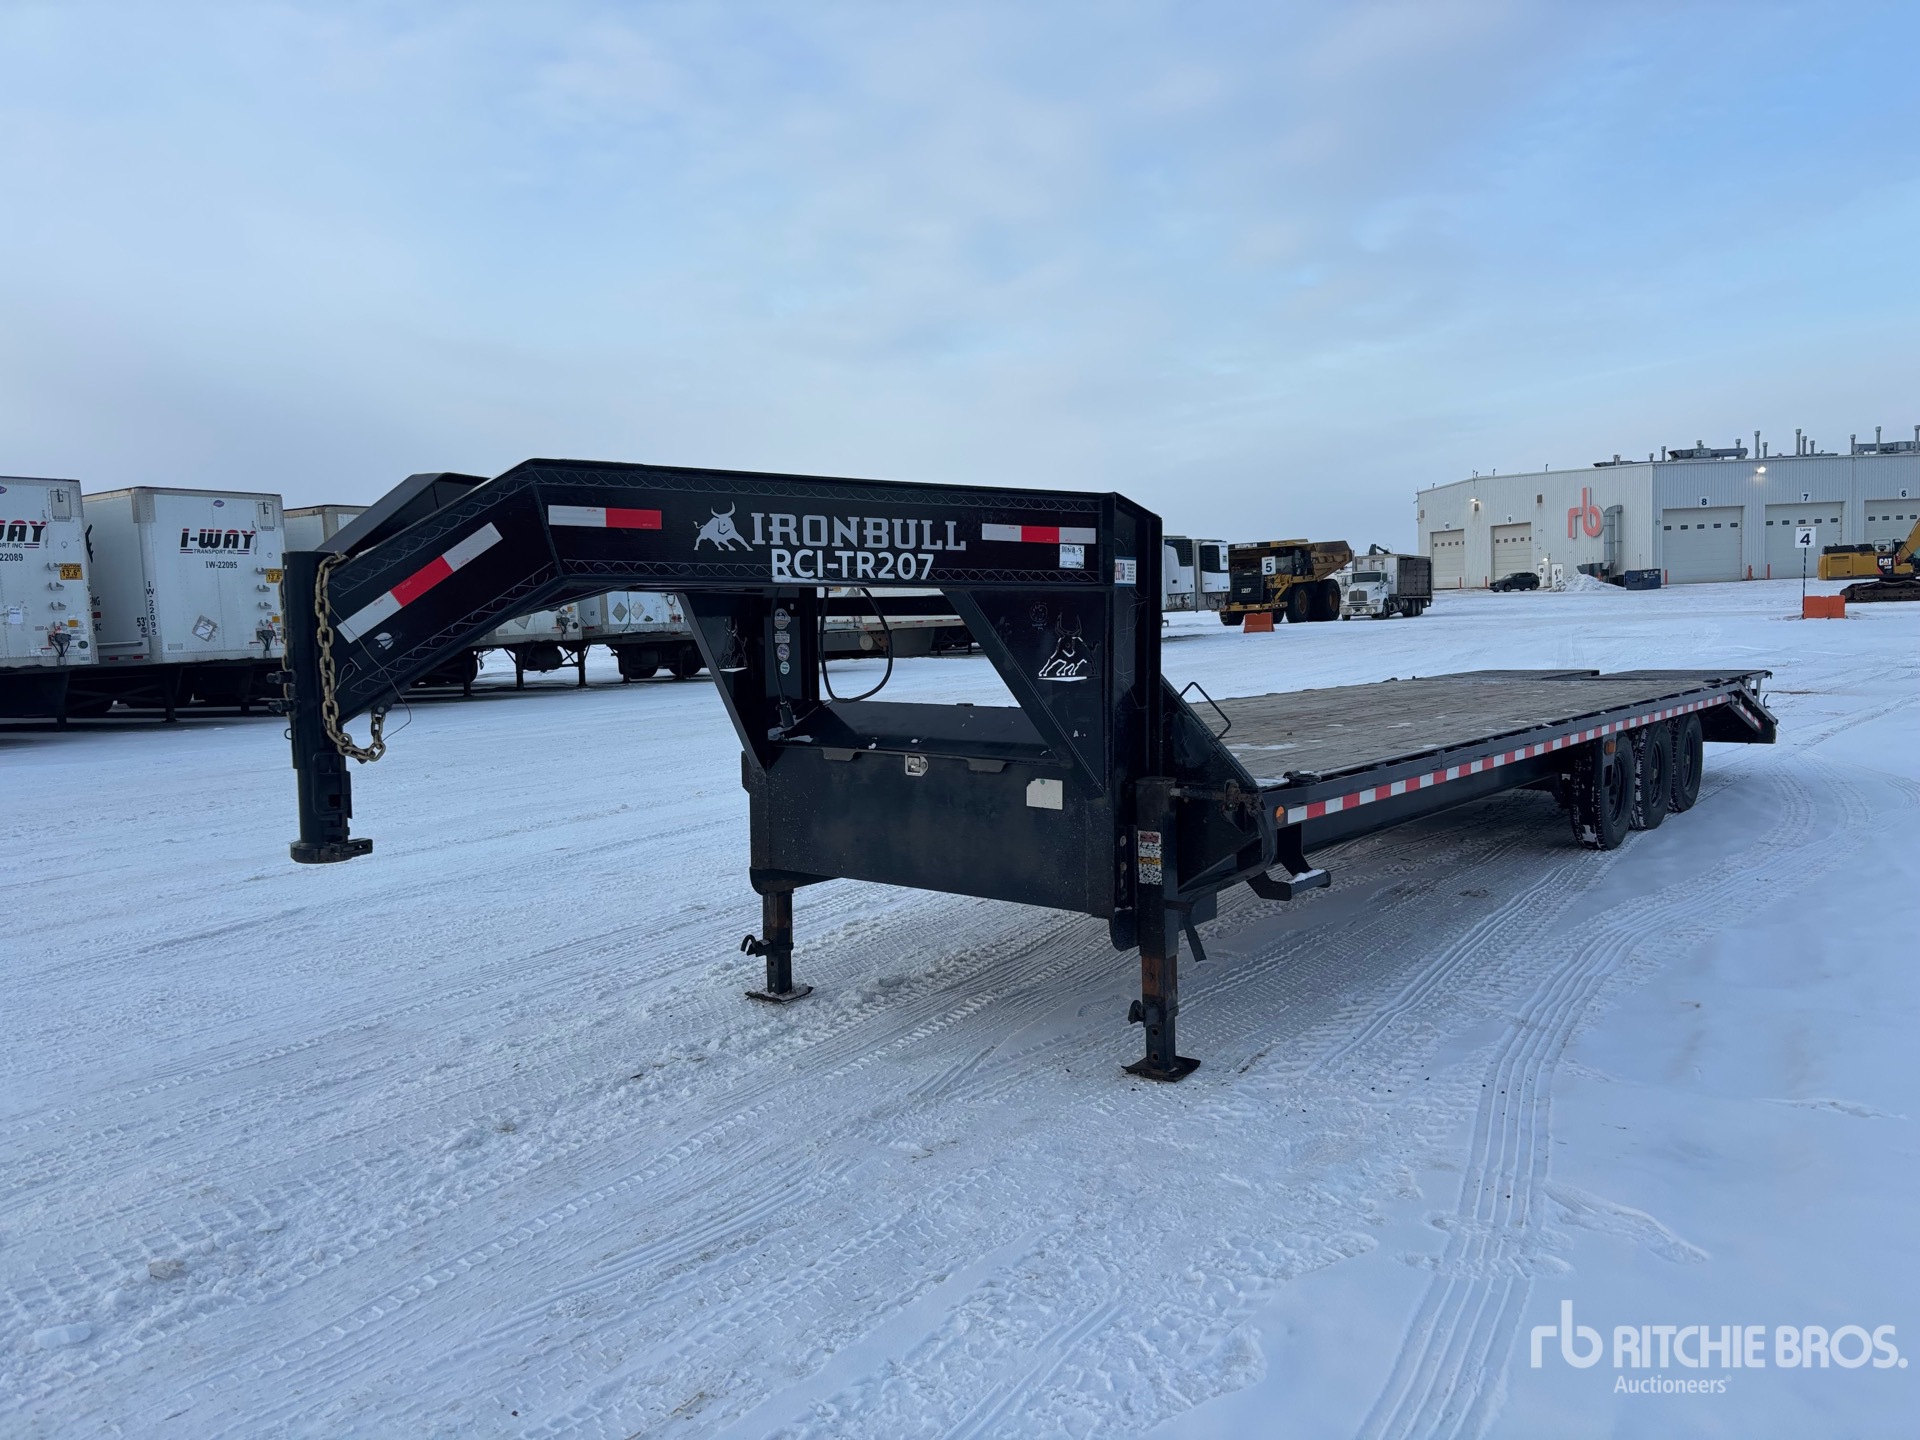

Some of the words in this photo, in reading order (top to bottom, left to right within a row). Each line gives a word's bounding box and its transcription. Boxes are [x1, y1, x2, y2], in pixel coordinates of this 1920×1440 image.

[1901, 490, 1907, 498] 6
[1701, 498, 1707, 506] 8
[1567, 486, 1603, 538] rb
[0, 519, 46, 542] AY
[750, 512, 967, 551] IRONBULL
[1800, 533, 1811, 546] 4
[205, 560, 238, 569] IW-22095
[771, 548, 935, 580] RCI-TR207
[1265, 562, 1272, 573] 5
[1878, 557, 1893, 566] CAT
